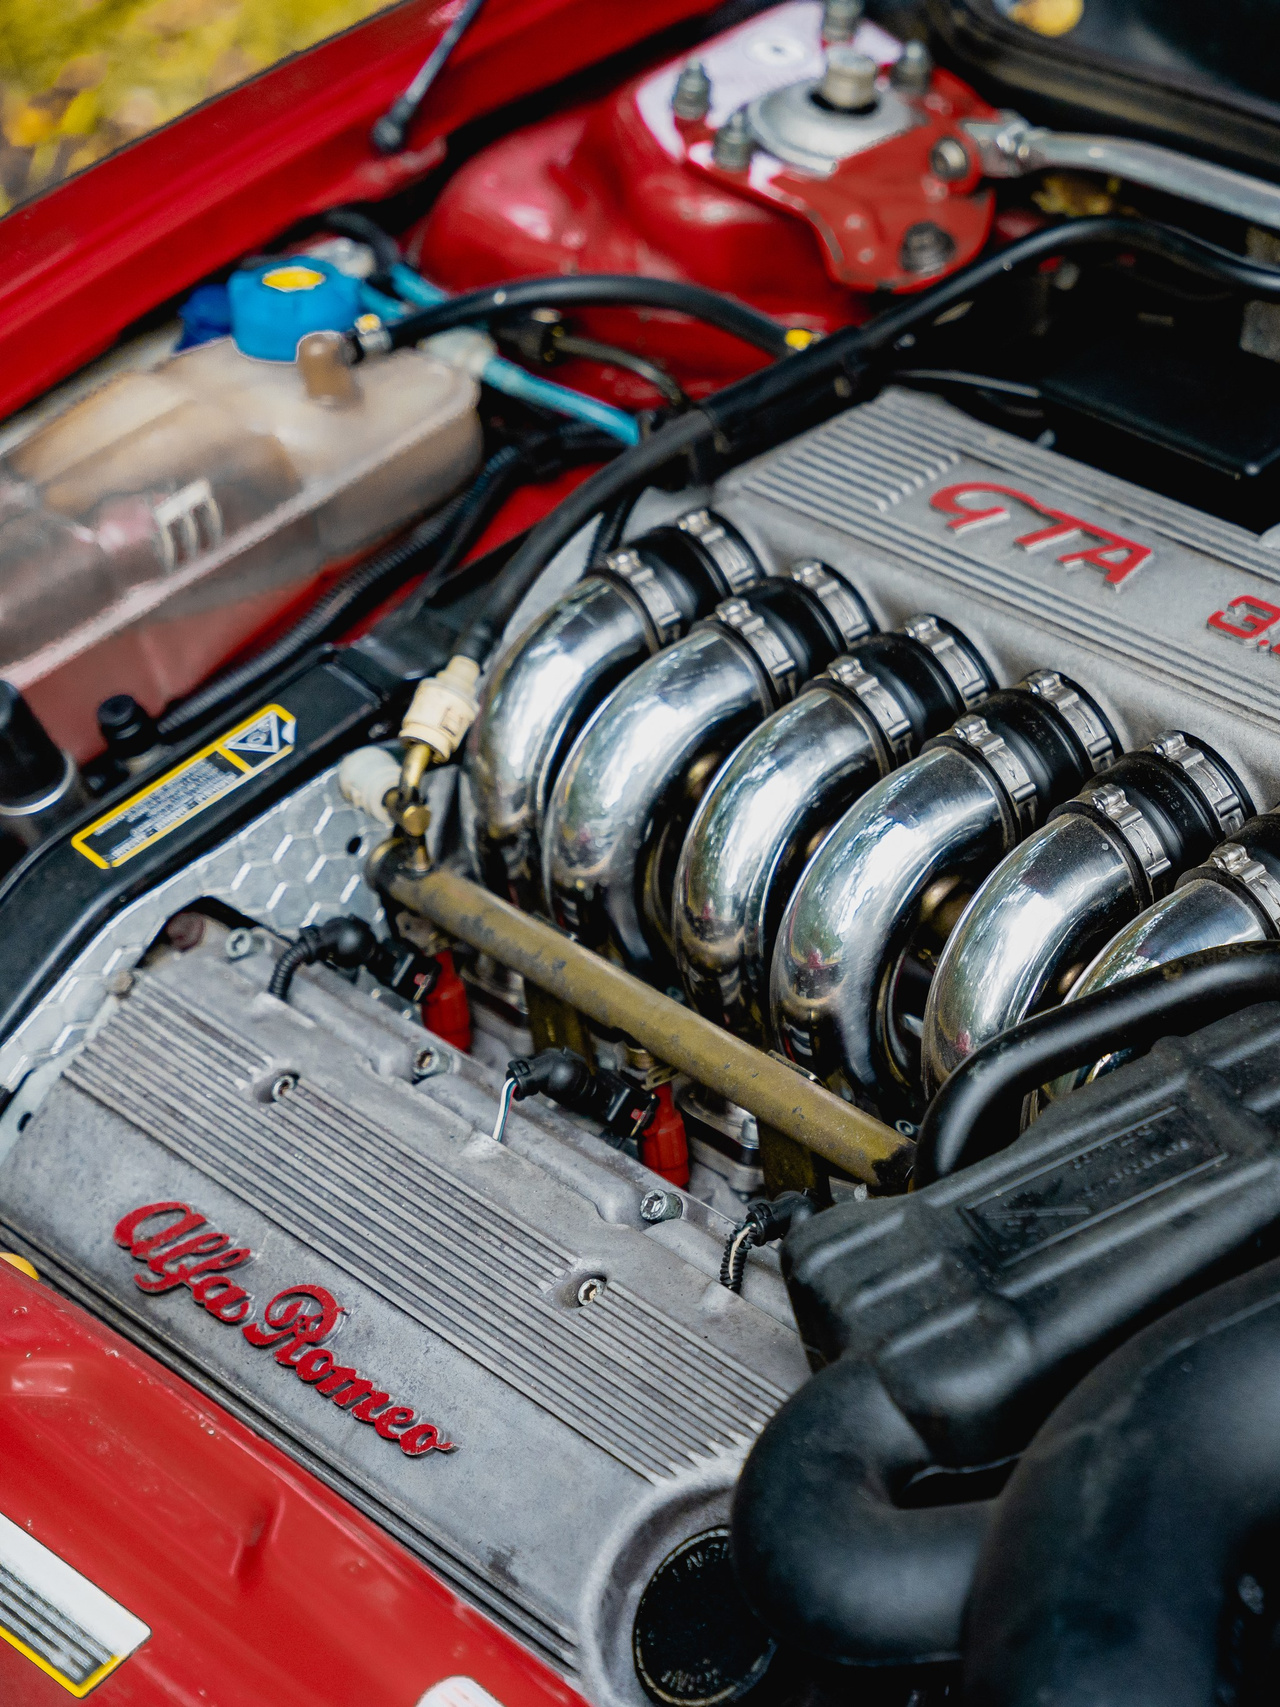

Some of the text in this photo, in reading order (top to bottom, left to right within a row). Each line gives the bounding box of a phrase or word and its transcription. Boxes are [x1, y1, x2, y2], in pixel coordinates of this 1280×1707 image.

[930, 482, 1152, 590] GTA
[113, 1201, 459, 1455] Alfa Romeo
